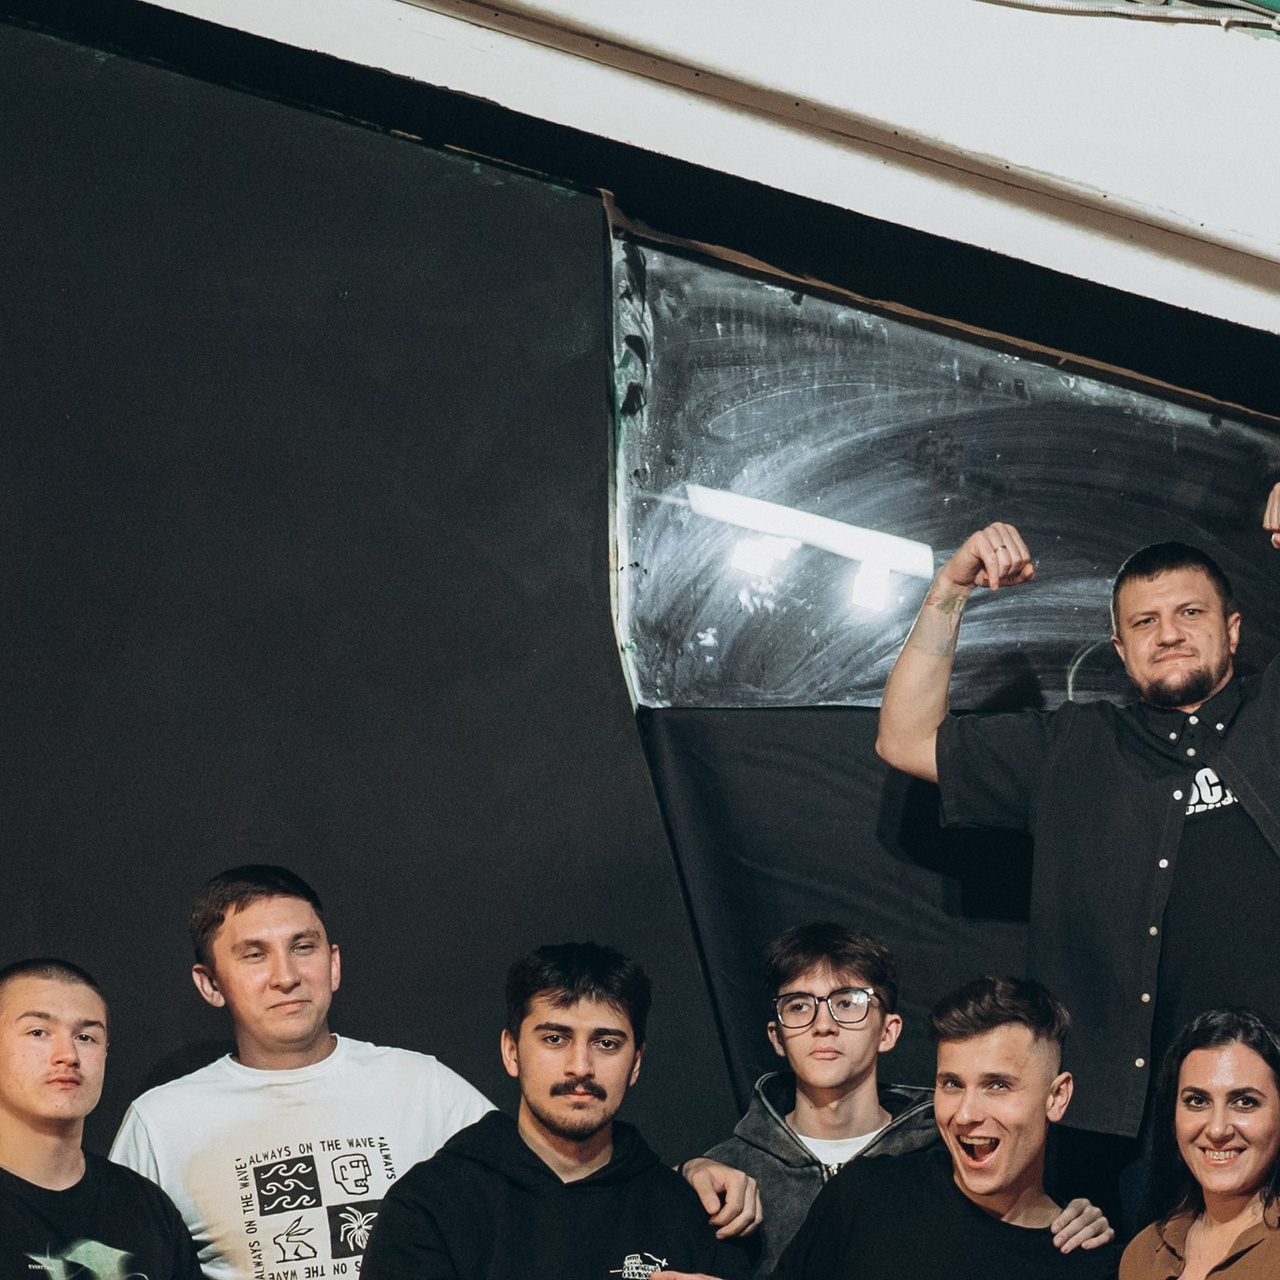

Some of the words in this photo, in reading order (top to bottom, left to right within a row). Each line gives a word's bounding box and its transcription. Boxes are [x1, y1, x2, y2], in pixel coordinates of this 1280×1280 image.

[249, 1145, 292, 1165] ALWAYS
[298, 1142, 313, 1154] ON
[319, 1139, 342, 1152] THE
[347, 1136, 376, 1148] WAVE
[377, 1142, 397, 1180] ALWAYS
[235, 1162, 247, 1190] WAVE
[240, 1193, 255, 1215] THE
[246, 1219, 257, 1235] ON
[248, 1241, 266, 1280] ALWAYS
[304, 1266, 326, 1279] THE
[333, 1264, 348, 1275] ON
